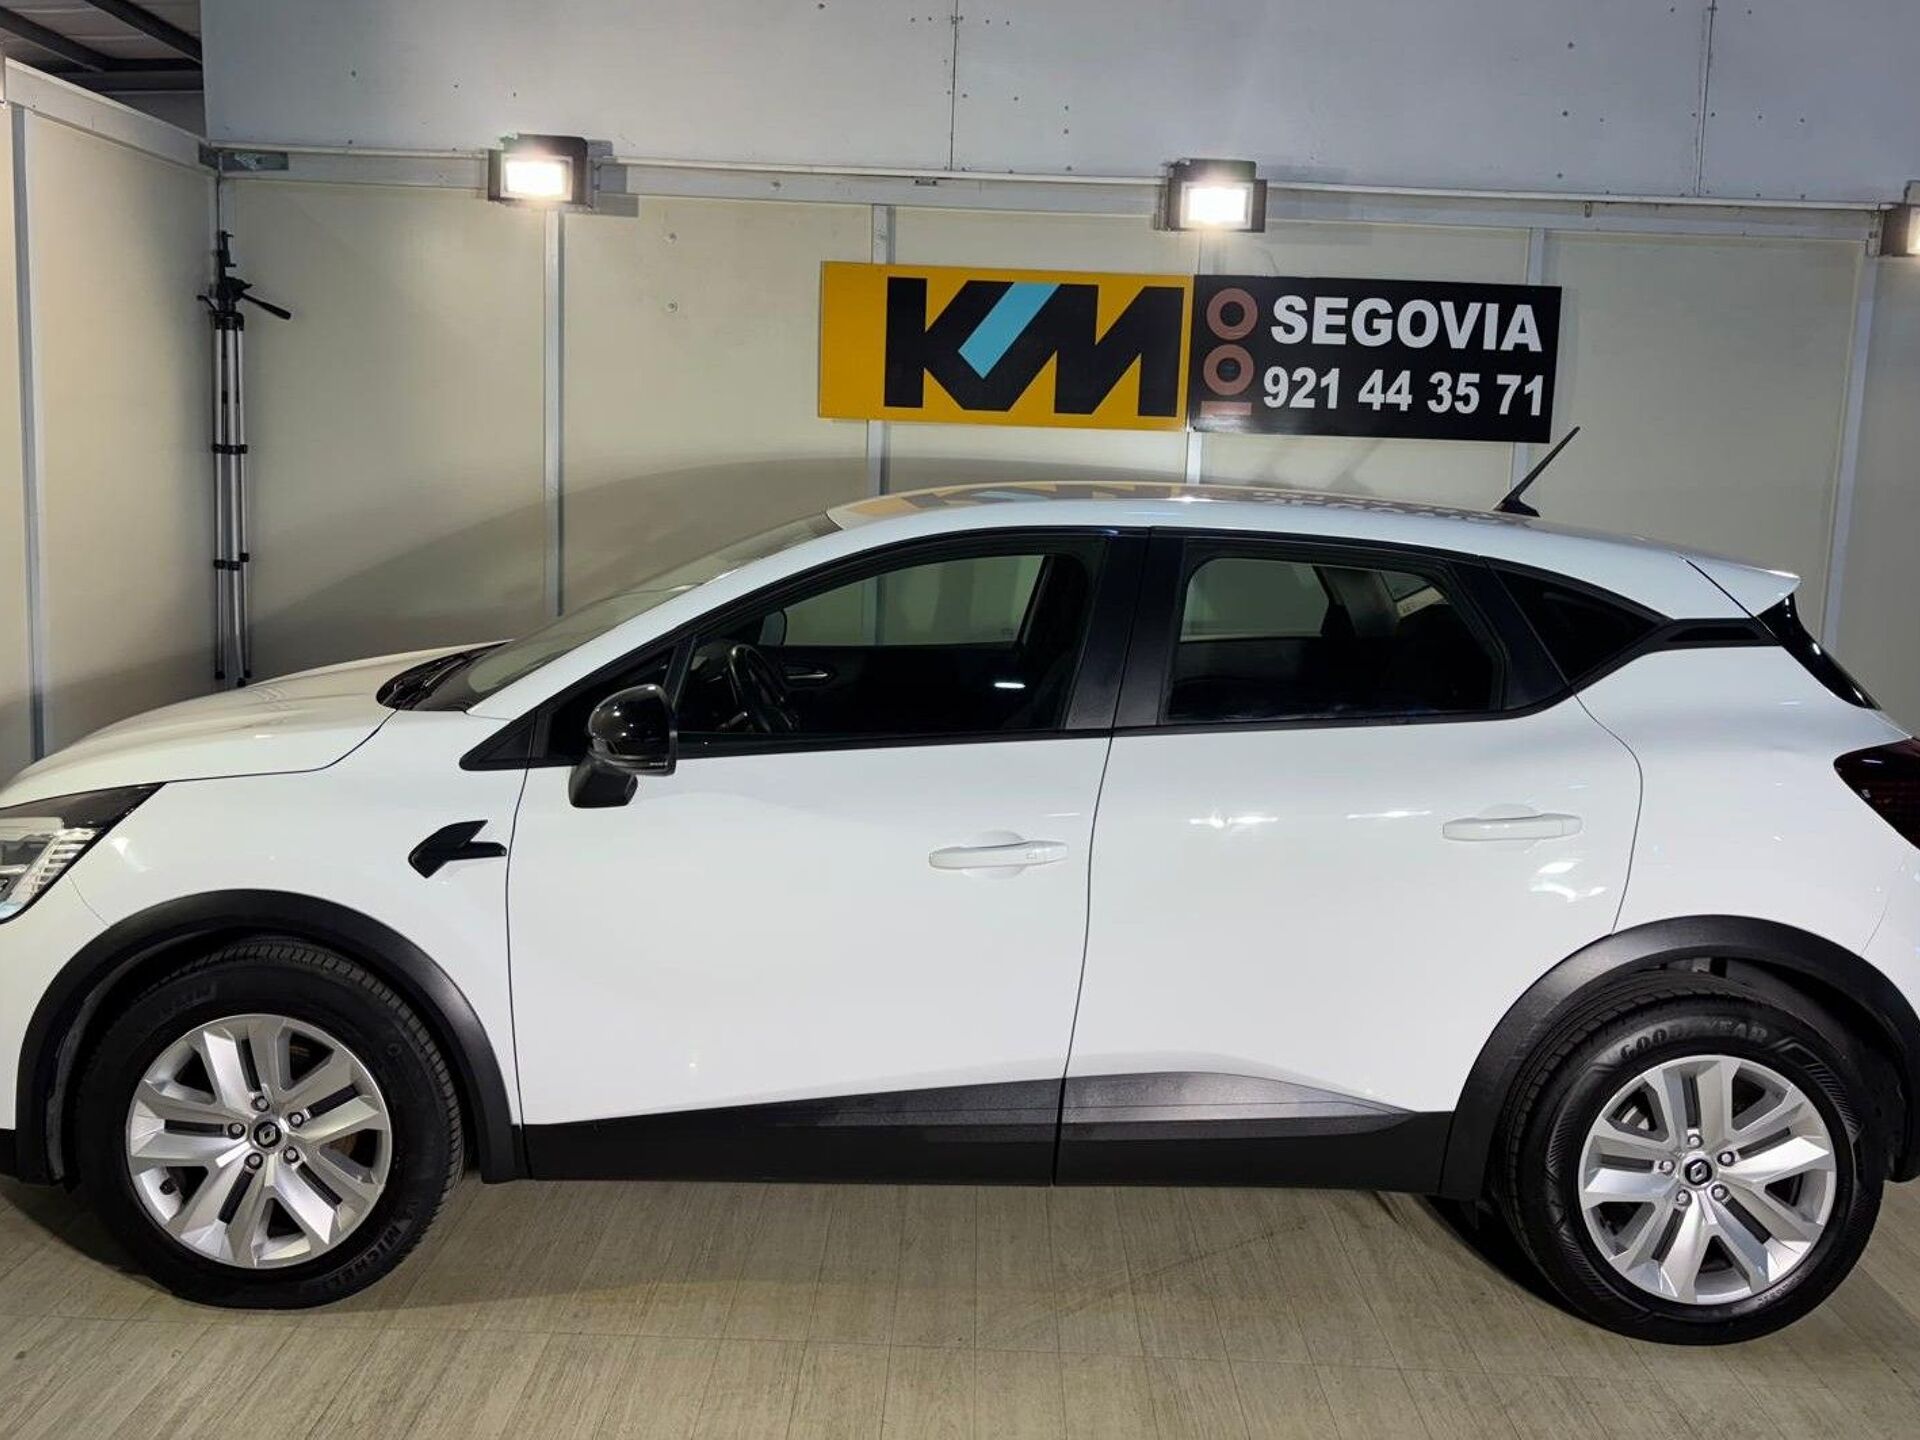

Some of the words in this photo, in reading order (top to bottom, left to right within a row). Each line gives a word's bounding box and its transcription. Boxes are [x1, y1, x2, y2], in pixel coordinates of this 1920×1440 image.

[884, 276, 1184, 417] KM
[1270, 294, 1543, 352] SEGOVIA
[1263, 366, 1340, 409] 921
[1358, 369, 1412, 411] 44
[1427, 371, 1480, 414] 35
[1497, 374, 1544, 416] 71
